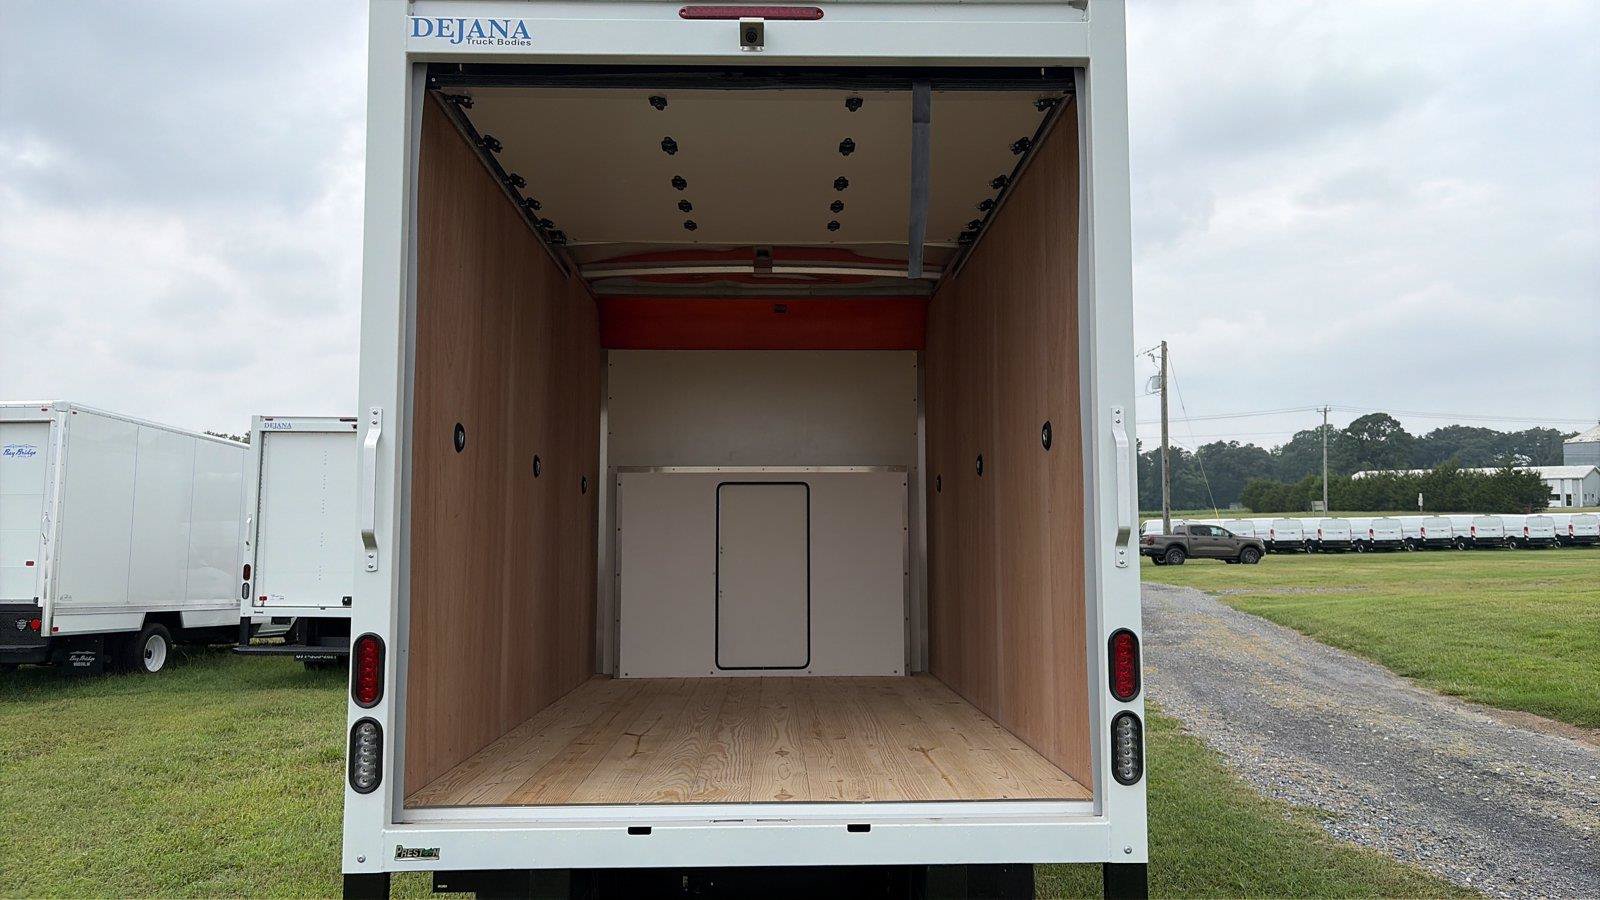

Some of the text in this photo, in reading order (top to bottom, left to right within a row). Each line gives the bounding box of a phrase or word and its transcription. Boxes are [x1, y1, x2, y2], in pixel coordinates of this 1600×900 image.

[410, 17, 532, 45] DEJANA
[467, 37, 532, 47] Truck Bodies
[264, 422, 292, 430] DEJANA
[16, 448, 37, 457] Bridge
